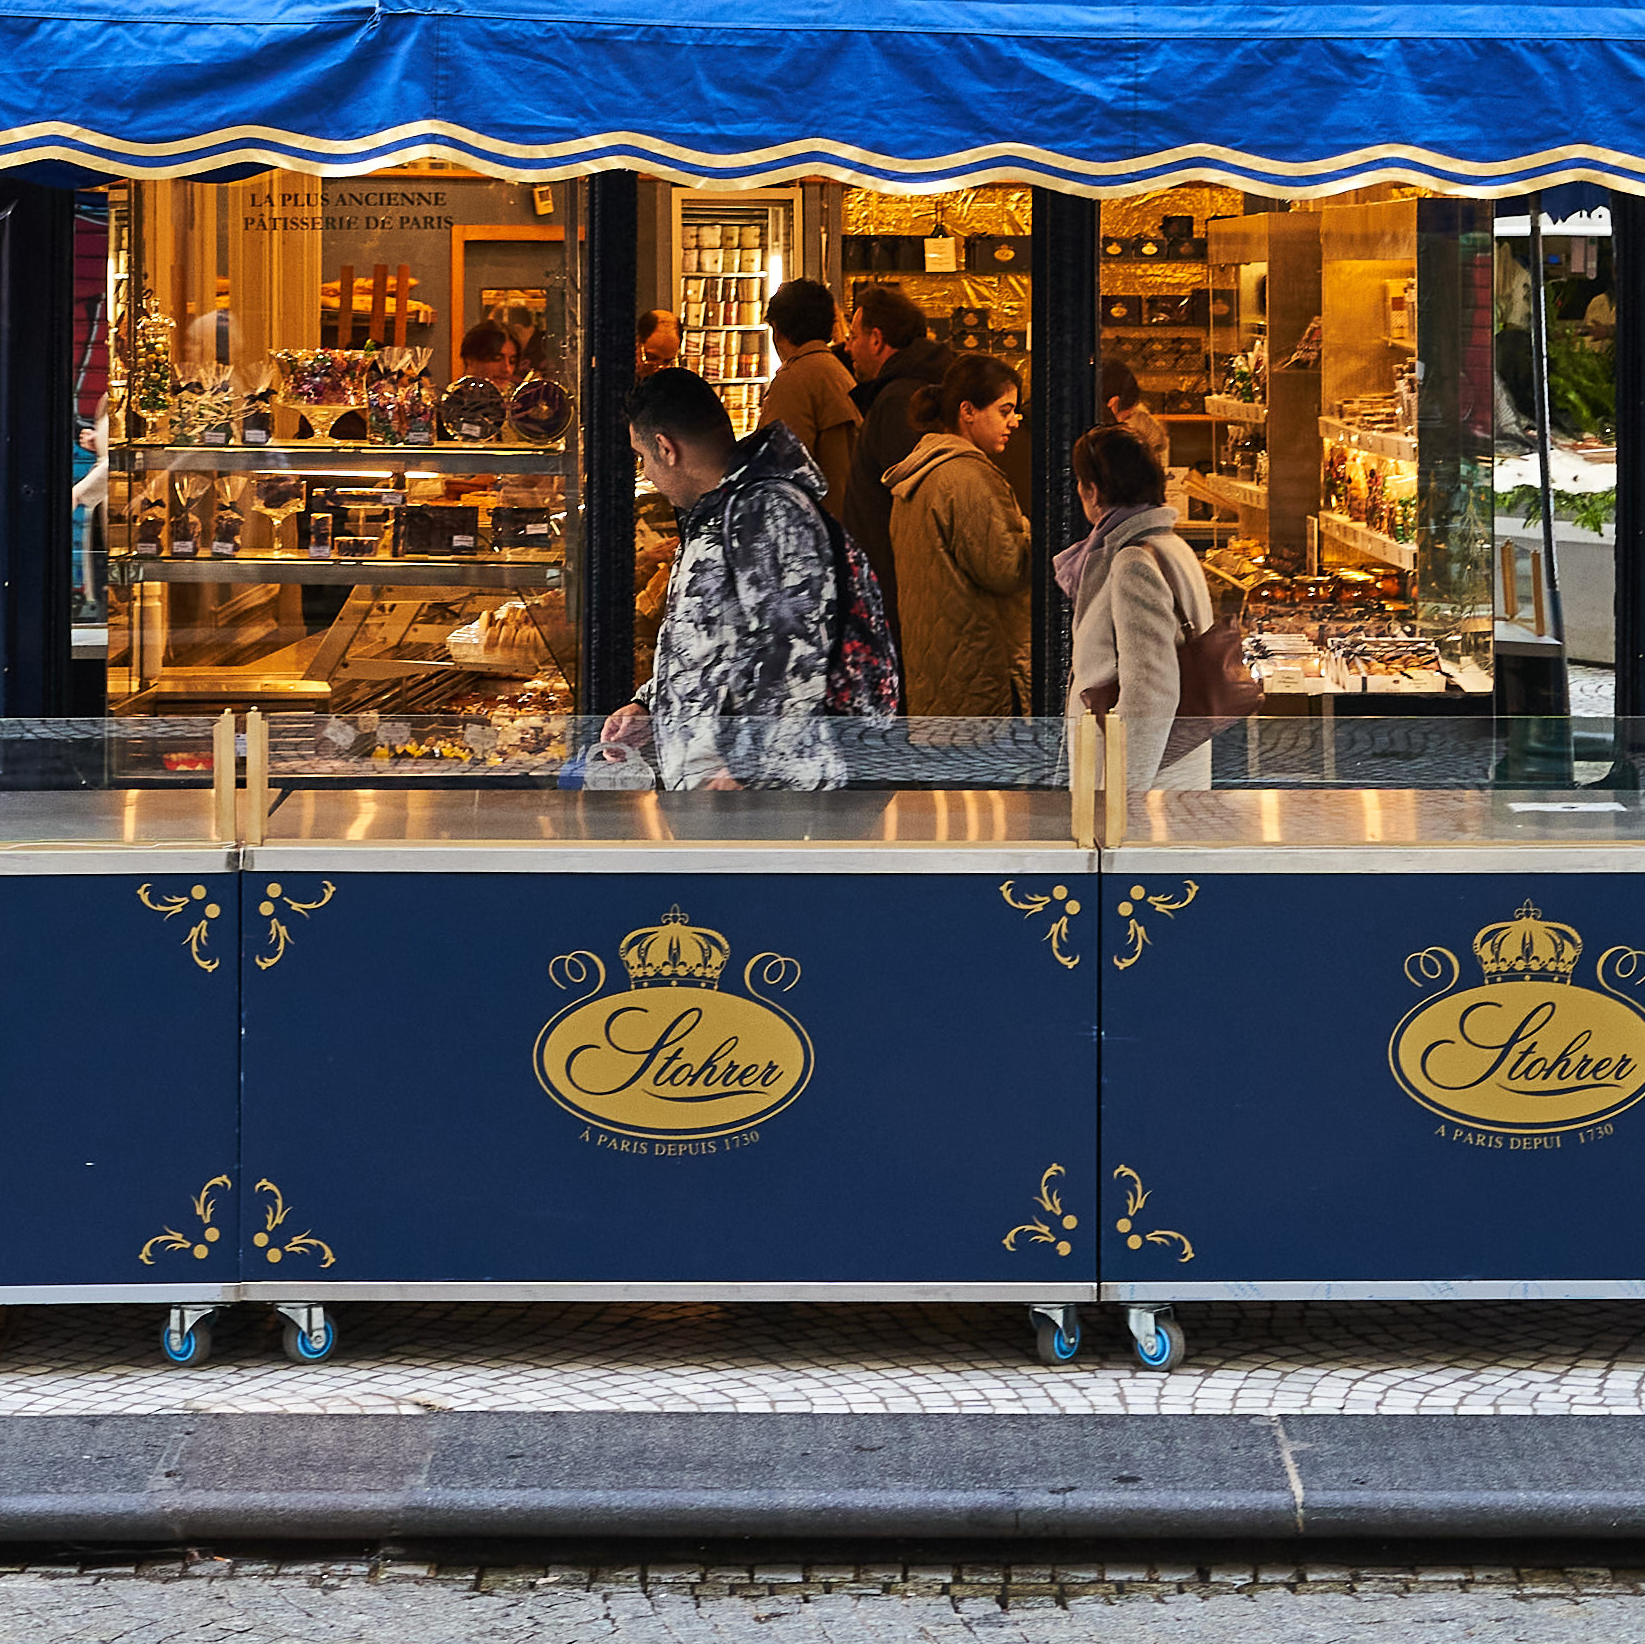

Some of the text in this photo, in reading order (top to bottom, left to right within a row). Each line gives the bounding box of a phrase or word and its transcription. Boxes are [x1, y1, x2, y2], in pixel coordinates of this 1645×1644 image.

[250, 192, 447, 207] LA PLUS ANCIENNE
[243, 213, 454, 231] PÂTISSERIE DE PARIS
[565, 1005, 784, 1102] Stohrer
[1420, 1001, 1637, 1097] Stohrer
[596, 1134, 649, 1155] PARIS
[654, 1141, 717, 1156] DEPUIS
[724, 1130, 761, 1151] 1730
[1452, 1128, 1504, 1149] PARIS
[1578, 1123, 1614, 1144] 1730
